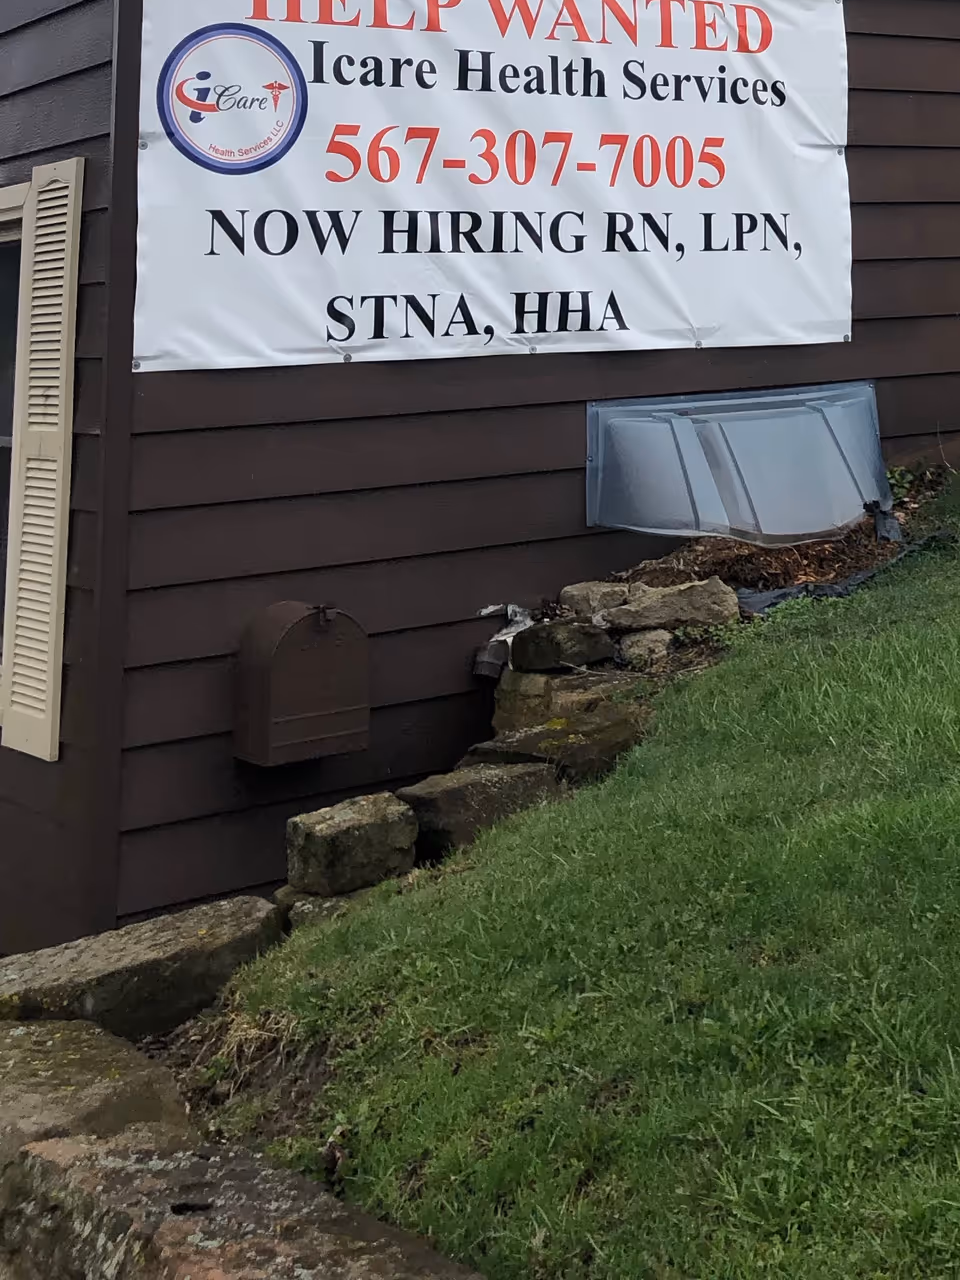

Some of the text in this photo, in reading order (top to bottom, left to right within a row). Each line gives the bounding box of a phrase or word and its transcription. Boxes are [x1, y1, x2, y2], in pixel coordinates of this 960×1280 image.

[308, 39, 787, 107] Icare Health Services
[208, 120, 284, 158] Health Services LLC
[324, 123, 727, 189] 567-307-7005
[204, 209, 804, 262] NOW HIRING RN, LPN,
[325, 290, 630, 345] STNA, HHA
